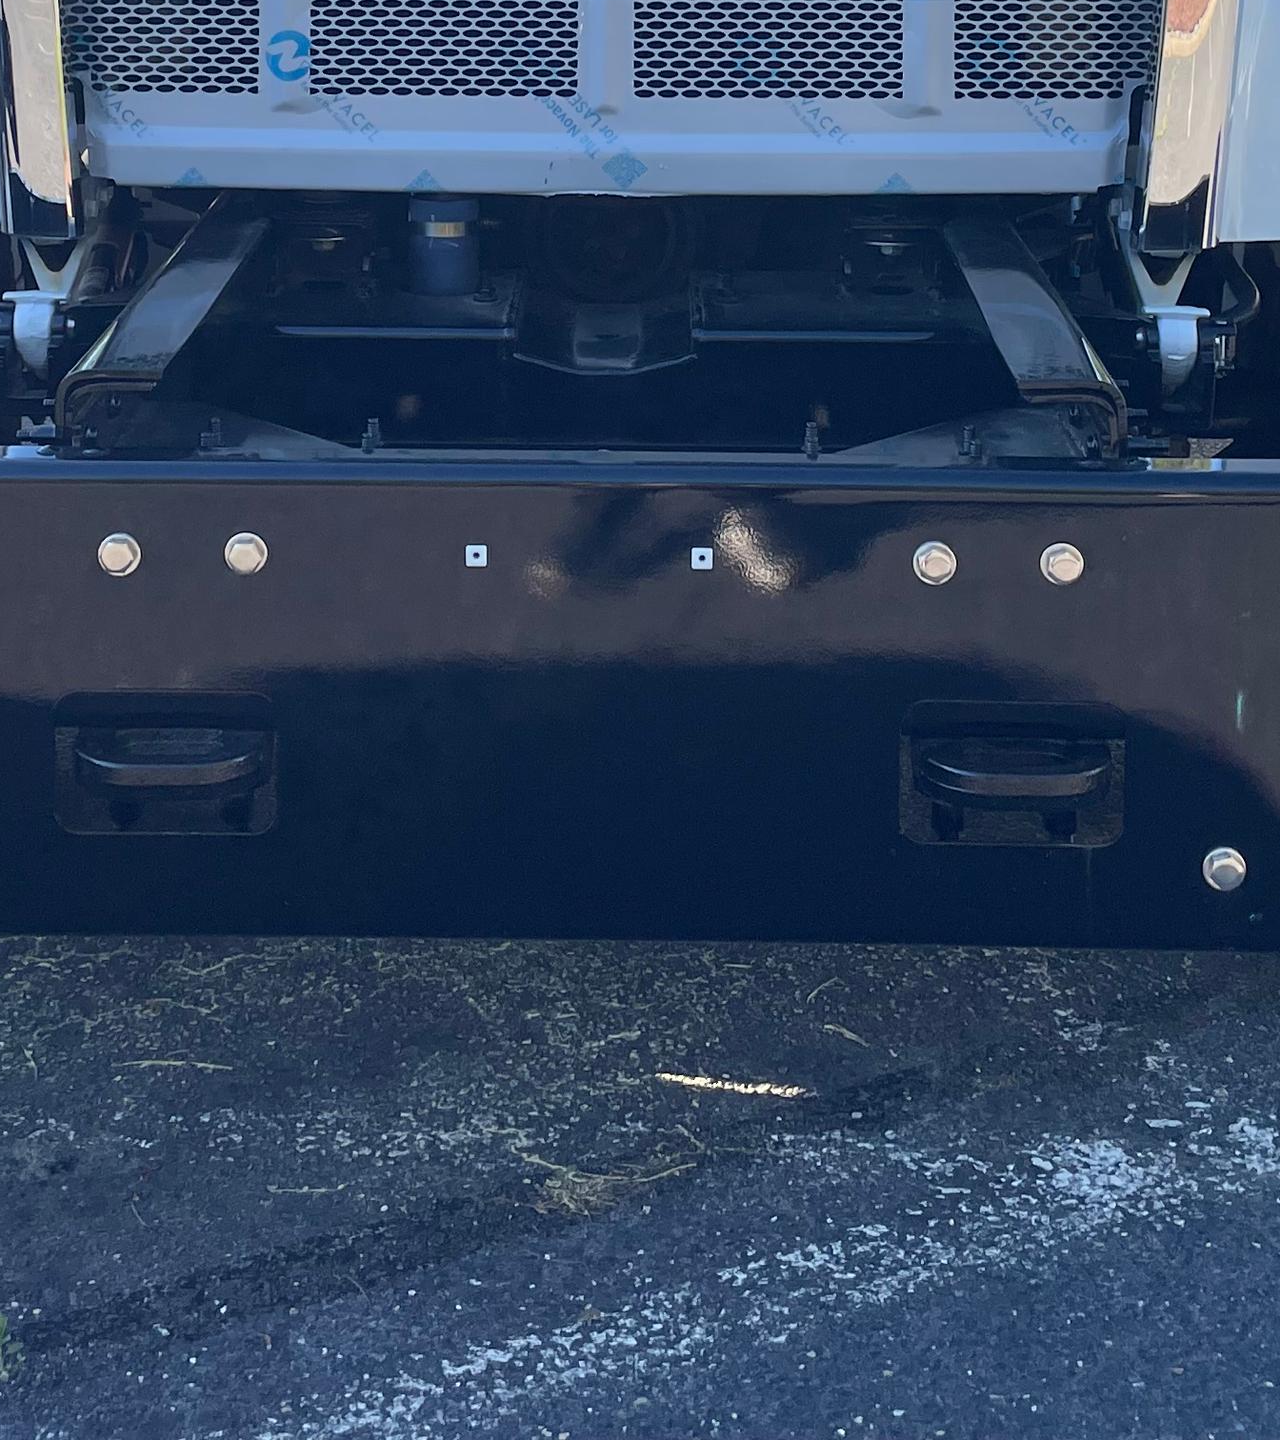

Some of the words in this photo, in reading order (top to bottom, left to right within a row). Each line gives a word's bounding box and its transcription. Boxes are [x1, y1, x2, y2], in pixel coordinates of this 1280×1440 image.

[103, 88, 149, 139] VACEL
[332, 94, 380, 143] VACEL
[800, 97, 849, 146] VACEL
[1033, 97, 1080, 146] VACEL
